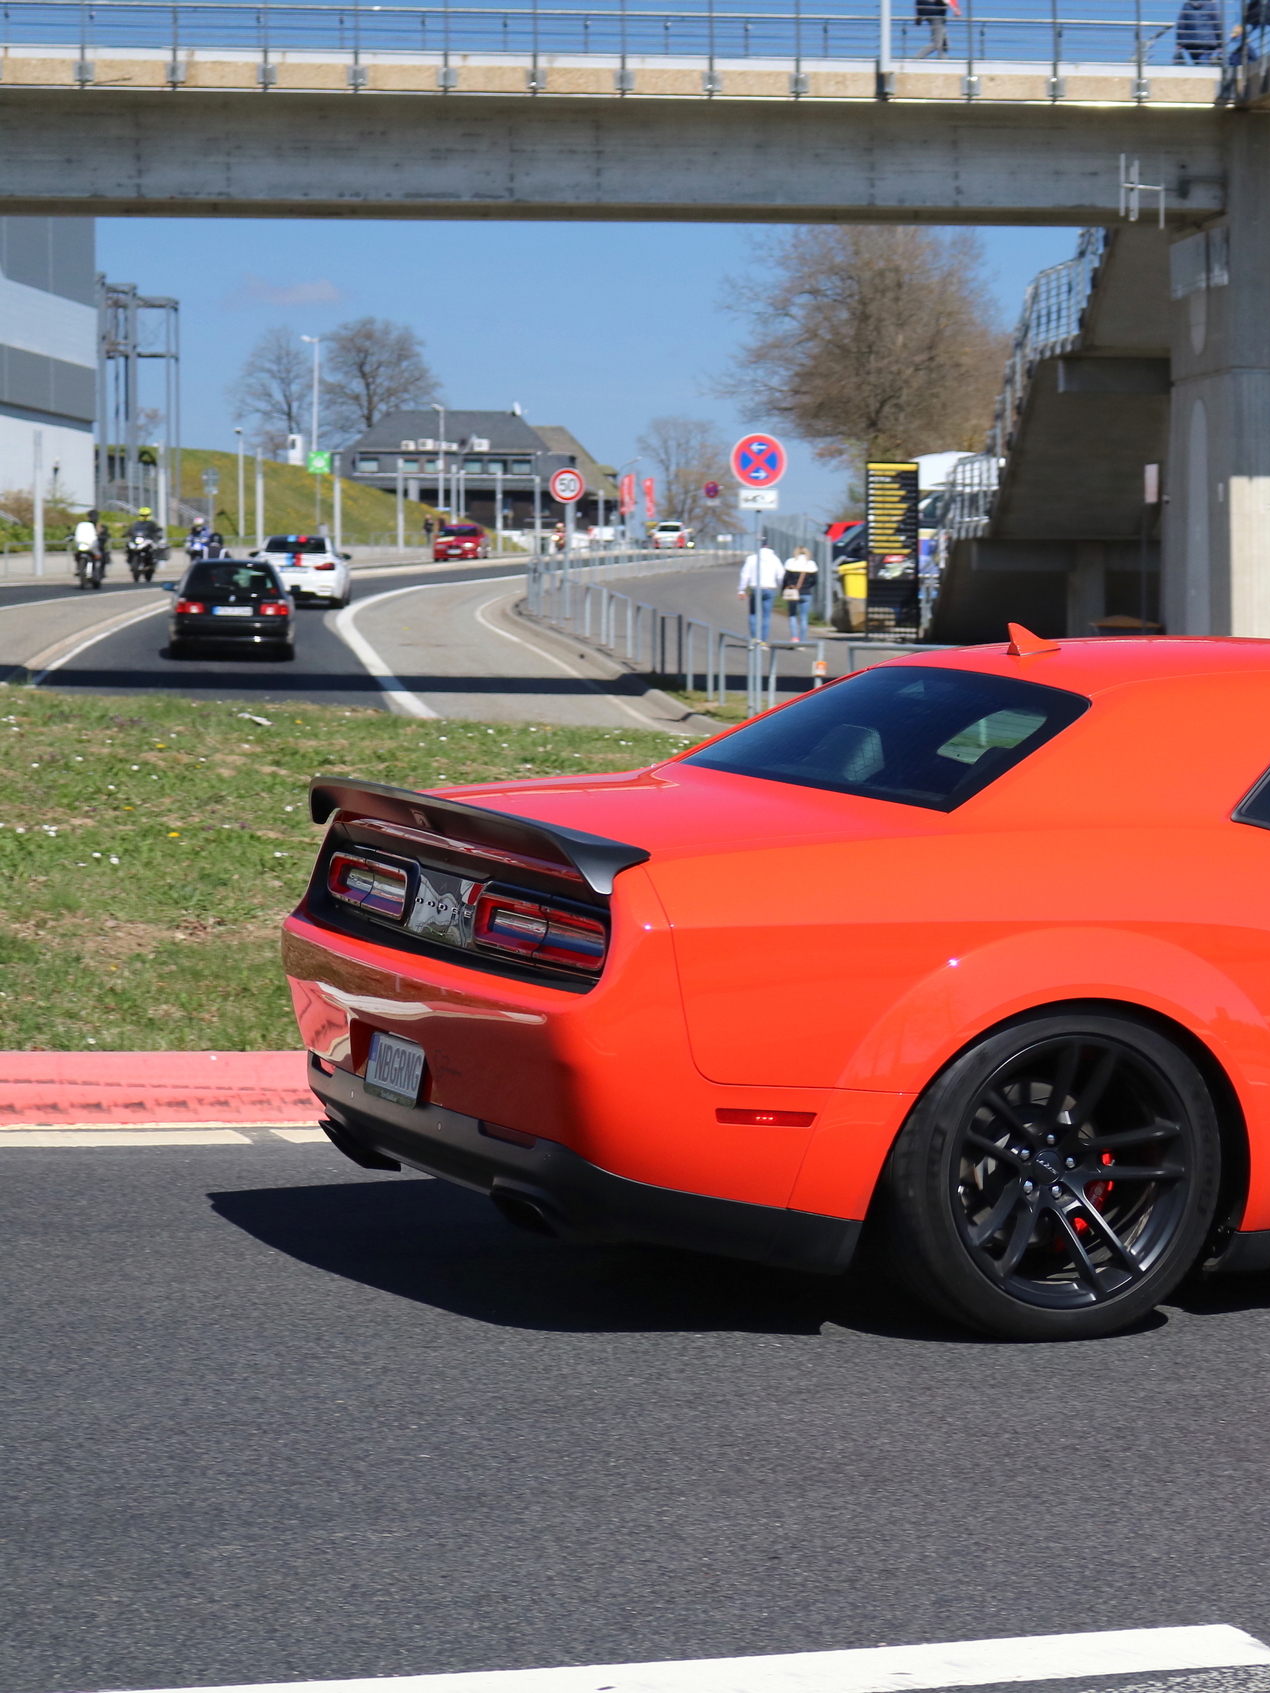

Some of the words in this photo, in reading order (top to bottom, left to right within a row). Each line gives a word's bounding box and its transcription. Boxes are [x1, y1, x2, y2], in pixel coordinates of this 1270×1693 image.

[559, 478, 577, 492] 50
[415, 897, 473, 919] DODGE
[374, 1041, 422, 1092] NBGRNG
